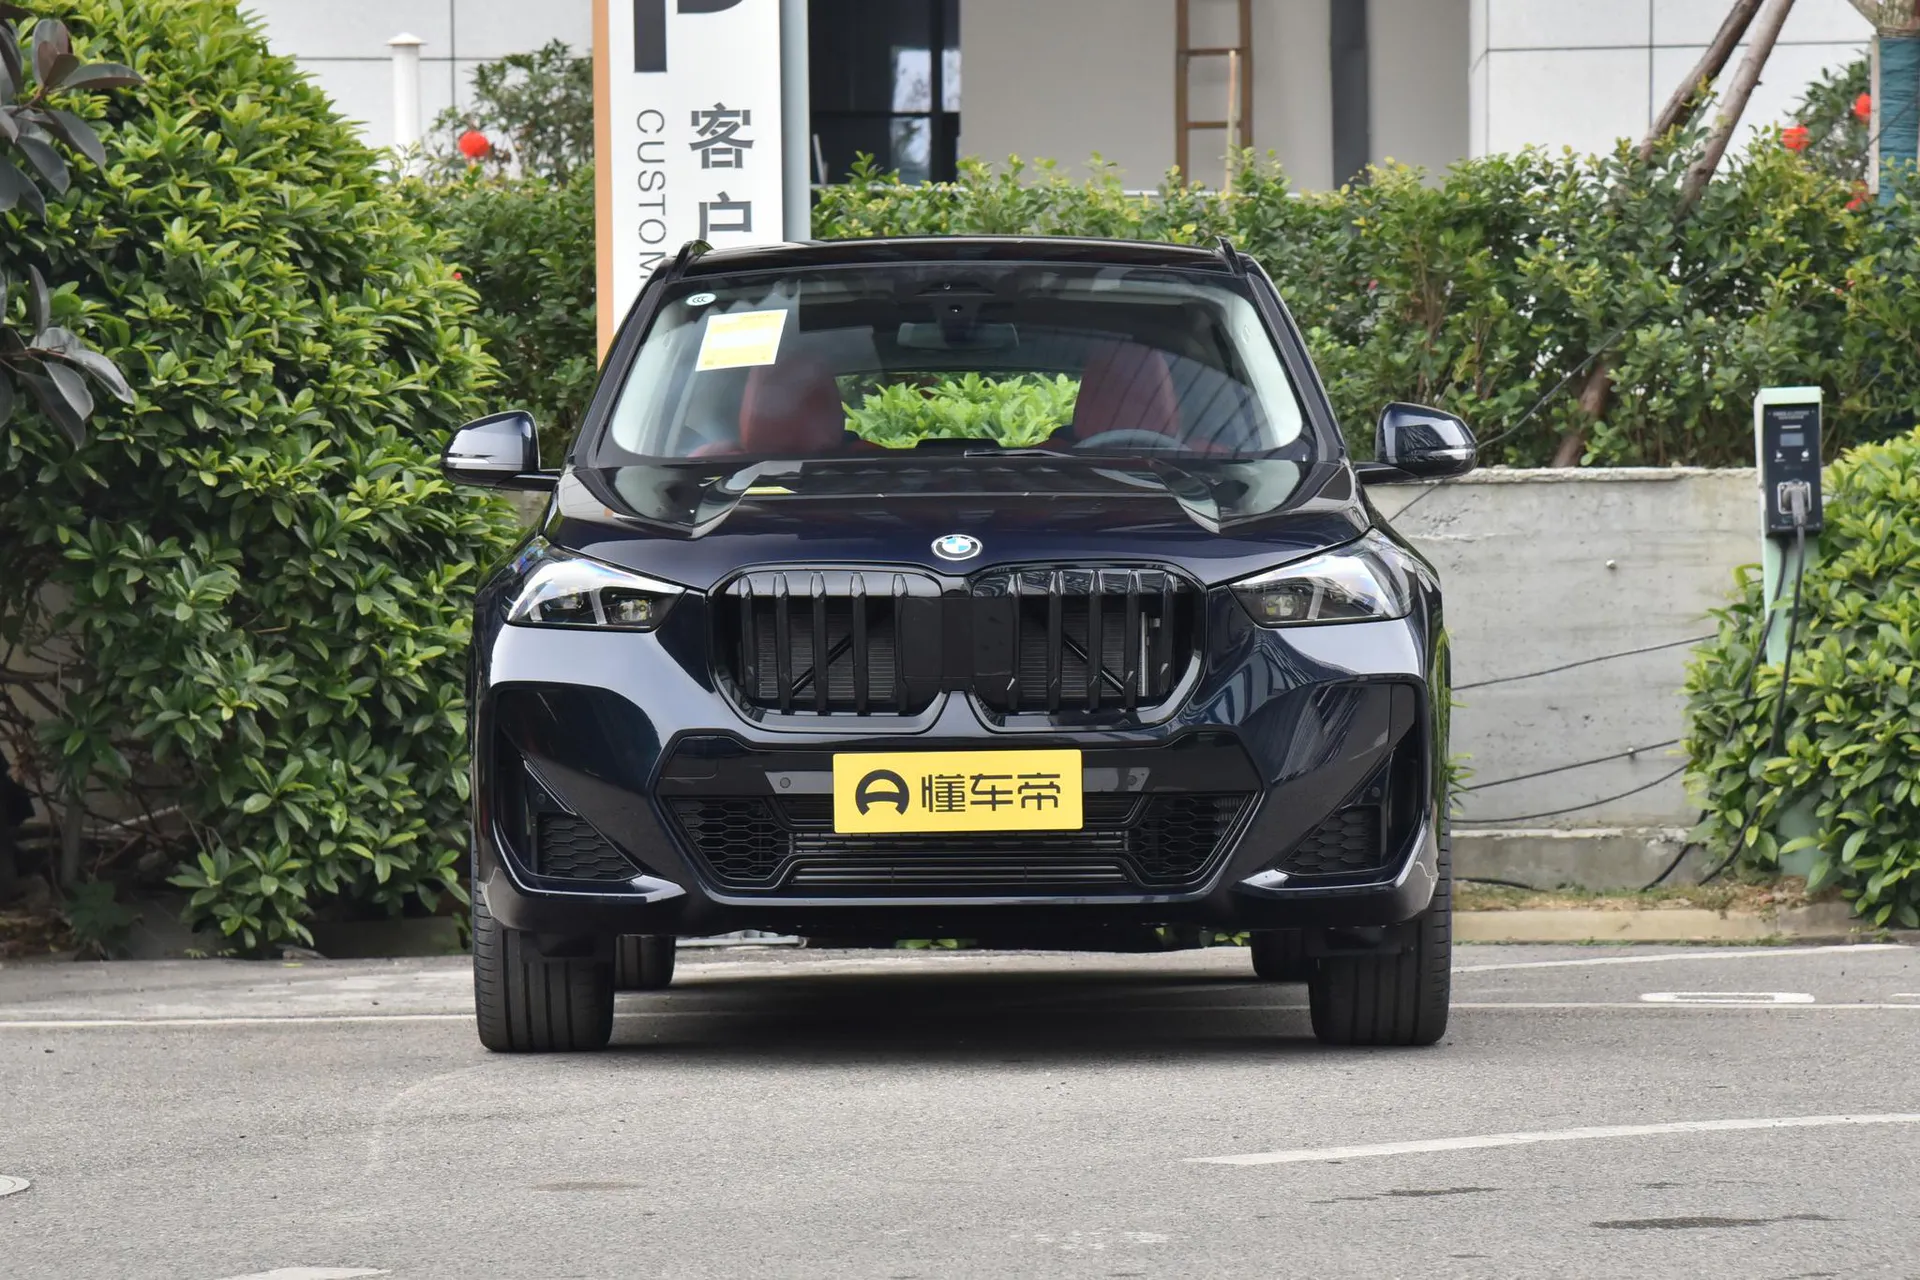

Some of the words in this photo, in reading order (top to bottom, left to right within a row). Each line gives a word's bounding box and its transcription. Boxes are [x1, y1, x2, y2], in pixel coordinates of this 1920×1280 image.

[689, 102, 754, 242] 客户
[921, 772, 1061, 812] 懂车帝
